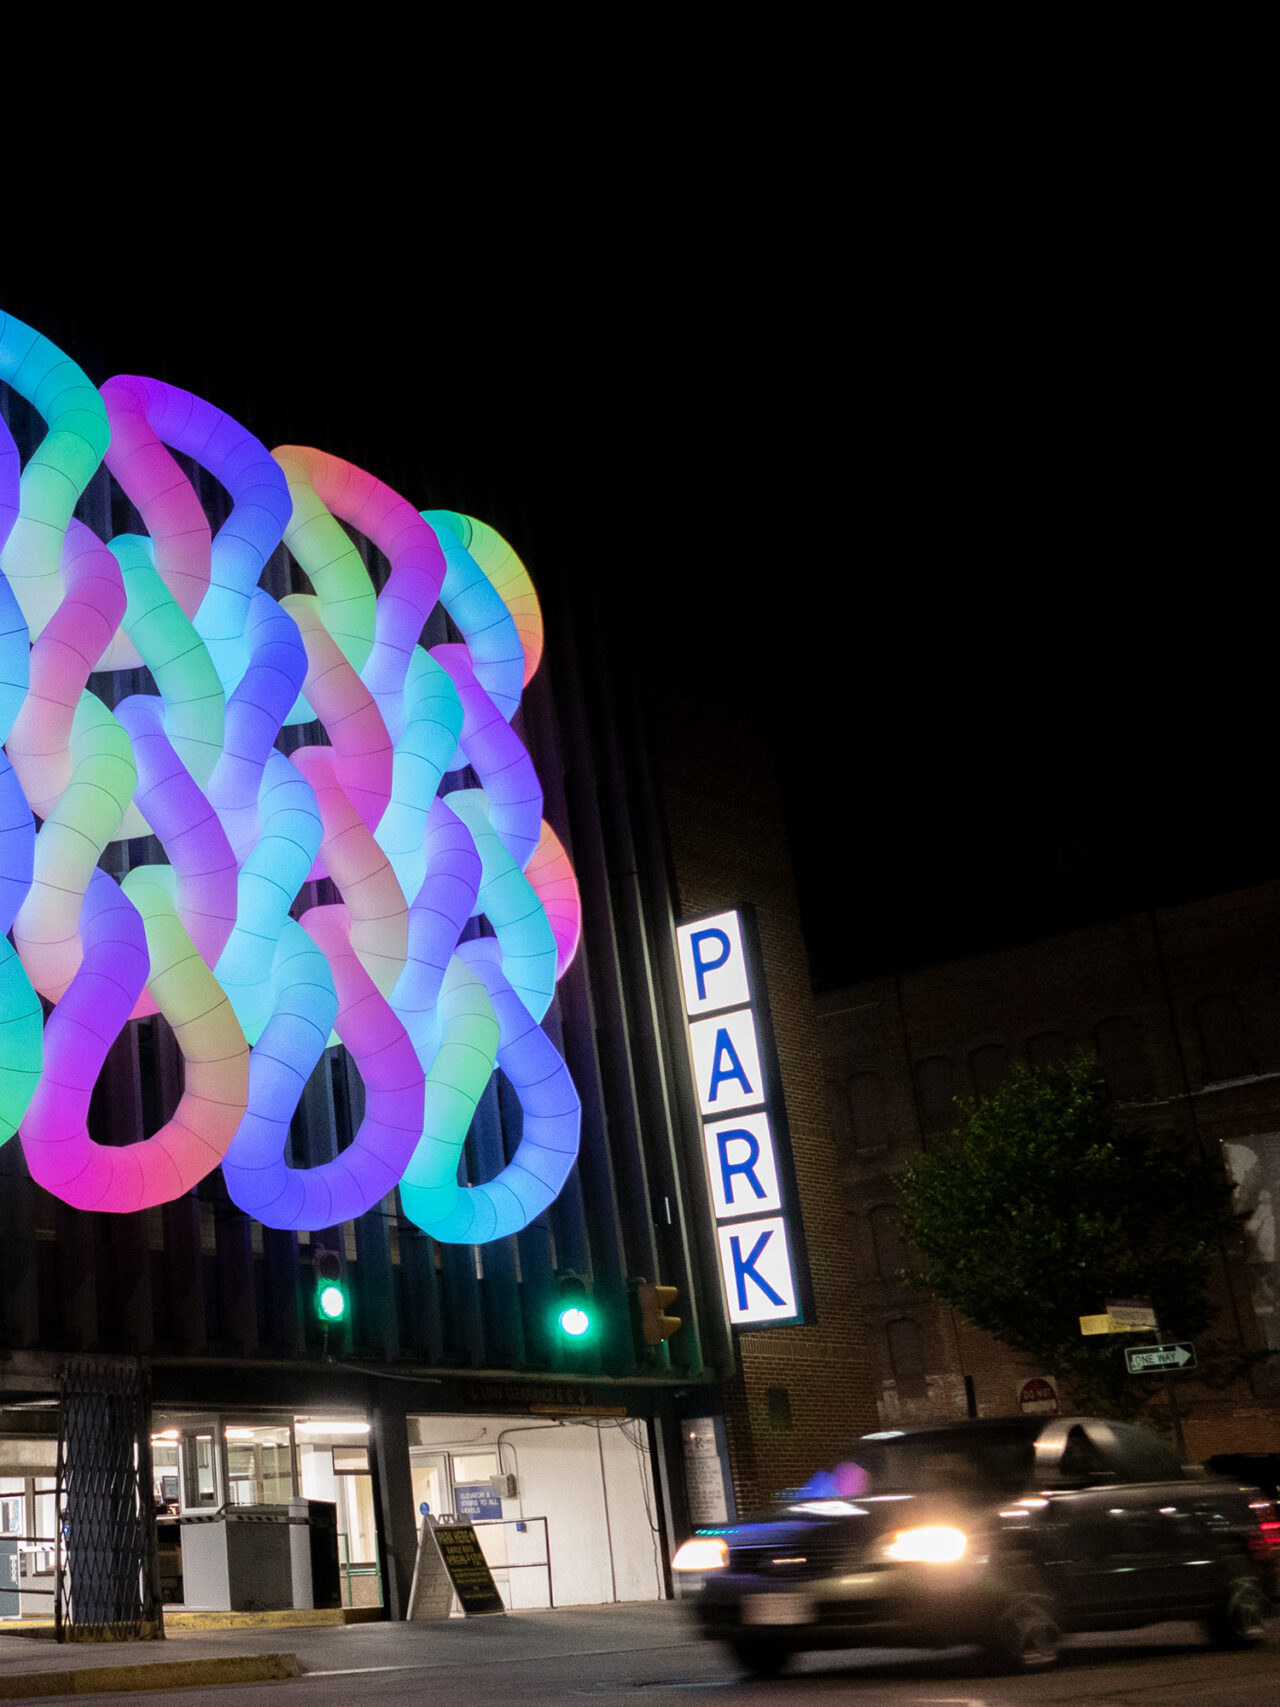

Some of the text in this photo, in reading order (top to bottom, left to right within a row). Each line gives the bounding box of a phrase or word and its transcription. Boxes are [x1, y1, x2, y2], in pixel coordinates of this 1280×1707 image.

[690, 927, 787, 1310] PARK
[1135, 1353, 1176, 1365] ONE WAY
[1023, 1390, 1035, 1400] DO
